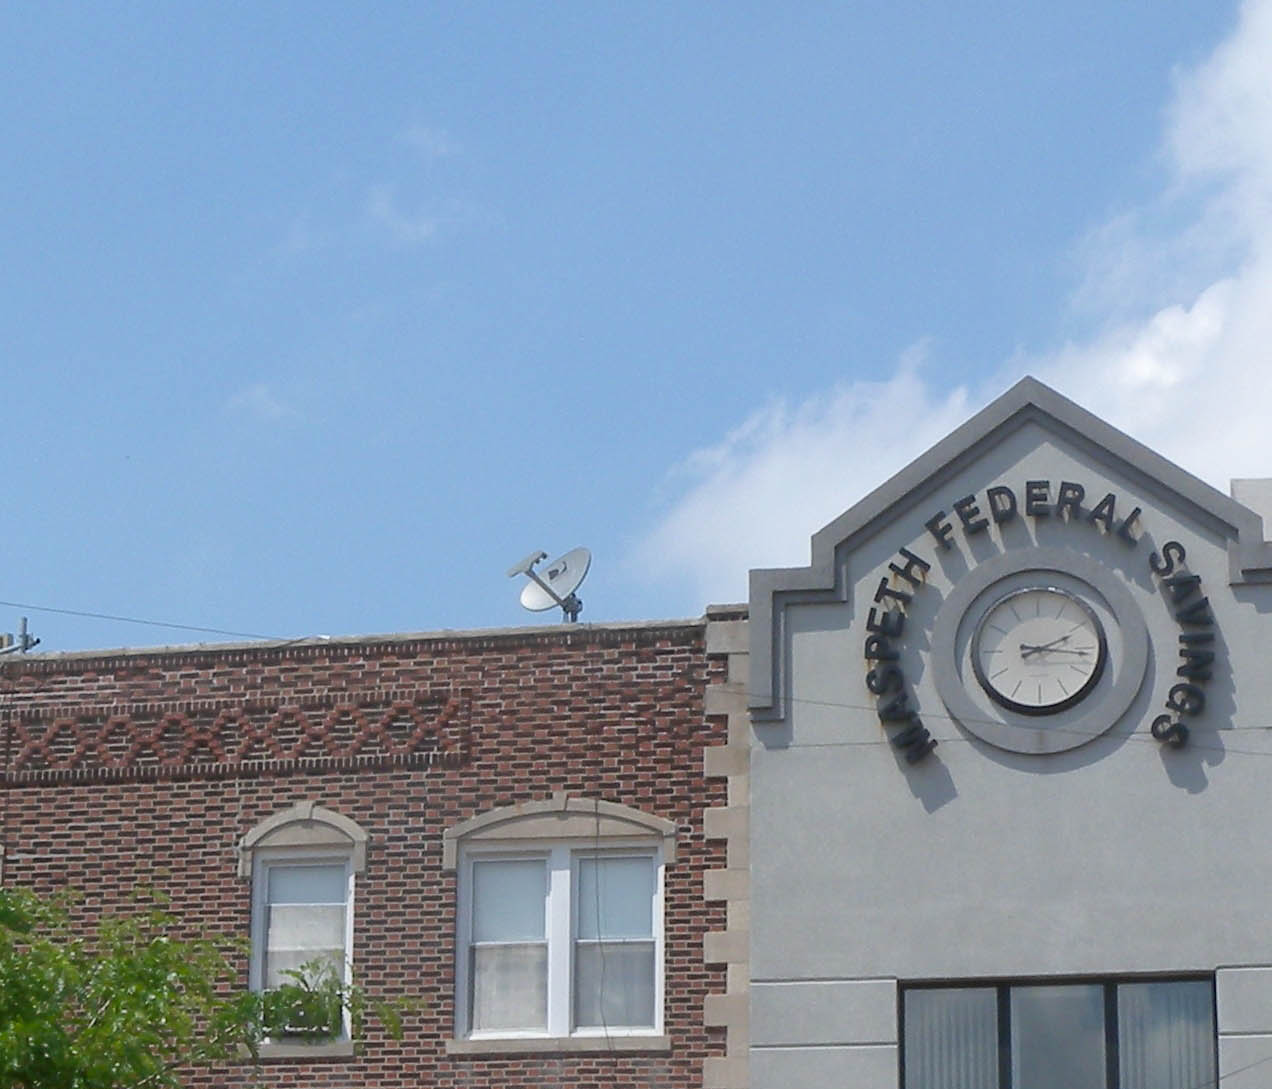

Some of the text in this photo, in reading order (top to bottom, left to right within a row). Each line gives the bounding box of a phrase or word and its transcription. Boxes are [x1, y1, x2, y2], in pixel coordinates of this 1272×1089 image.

[864, 480, 1215, 765] MASPETH FEDERAL SAVINGS
